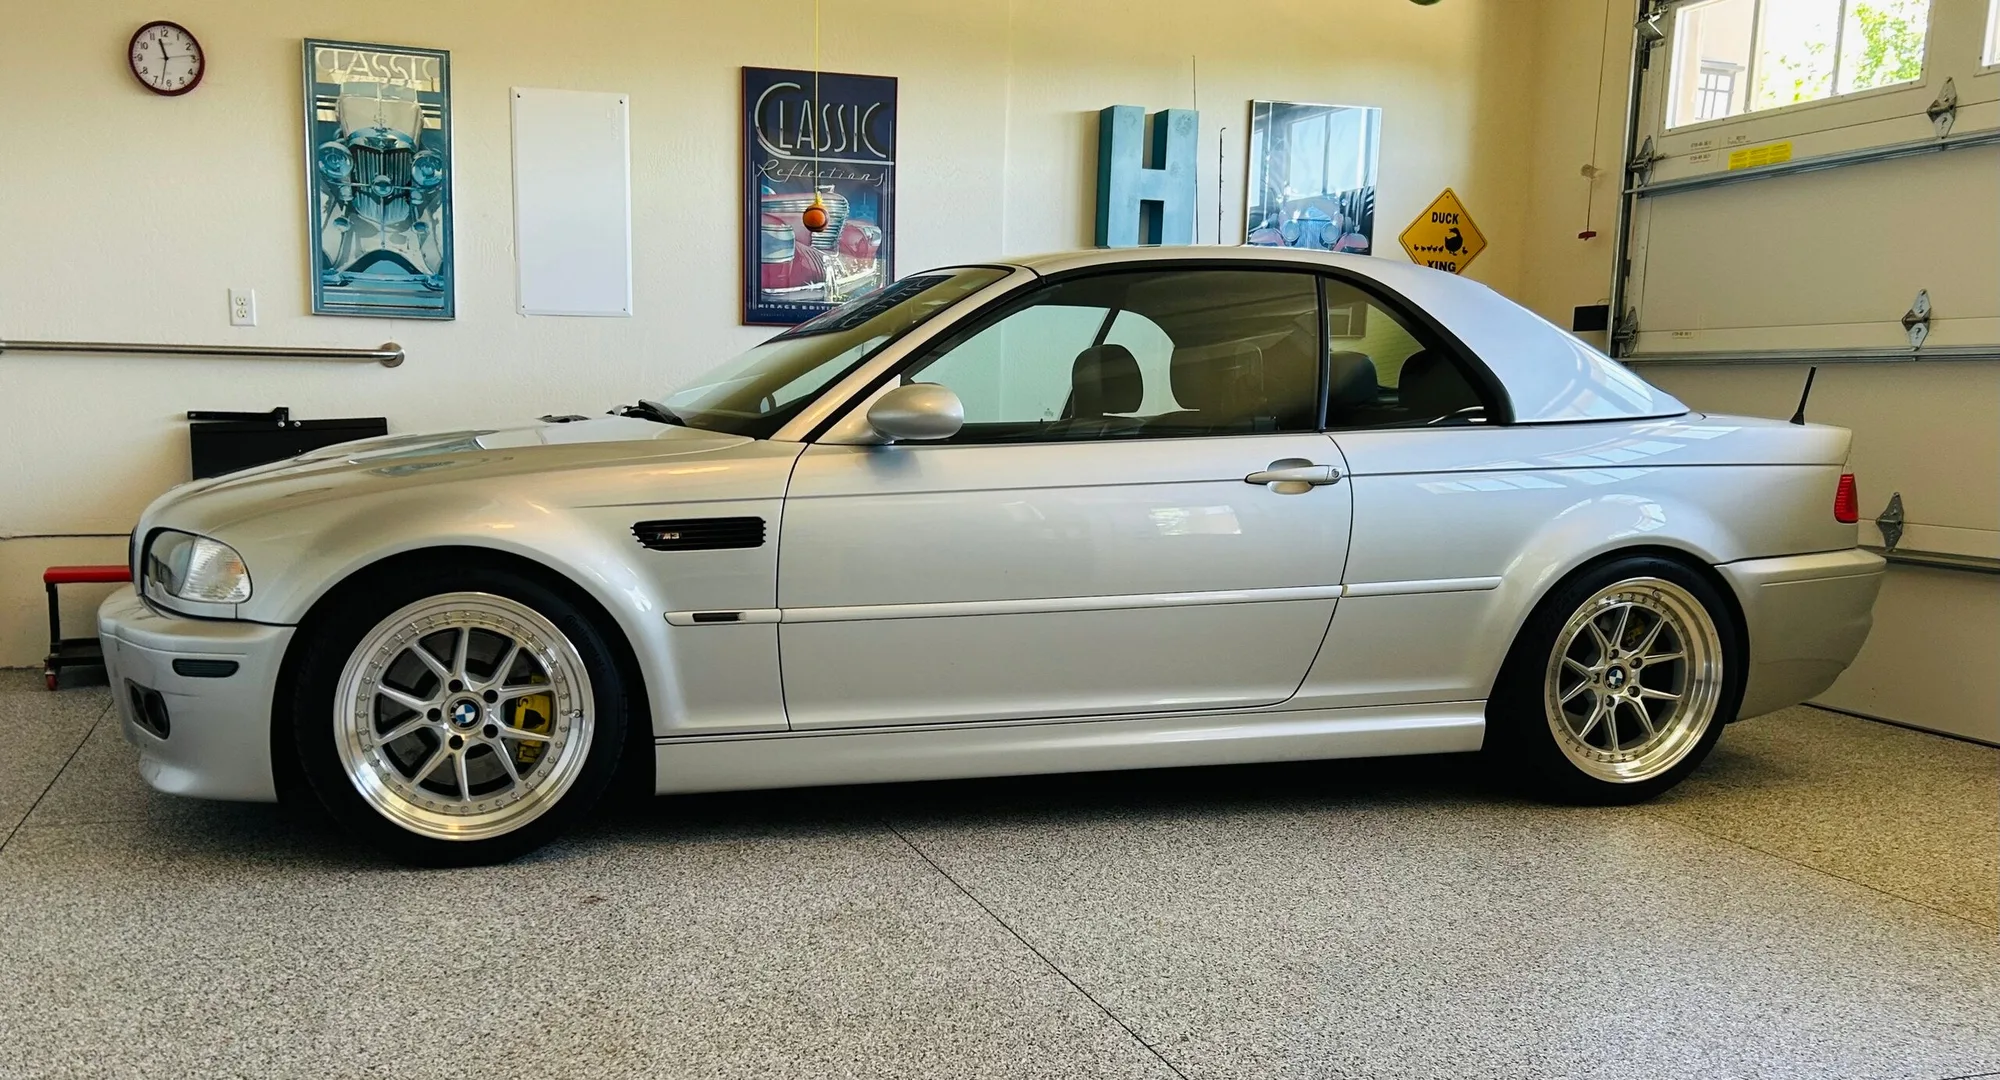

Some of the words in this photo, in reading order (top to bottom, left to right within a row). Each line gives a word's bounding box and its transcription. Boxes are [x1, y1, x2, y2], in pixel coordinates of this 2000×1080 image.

[149, 33, 156, 41] 11
[160, 29, 169, 38] 12
[140, 42, 149, 50] 10
[185, 42, 192, 51] 2
[136, 53, 143, 62] 9
[190, 54, 197, 64] 3
[142, 66, 149, 75] 8
[187, 68, 194, 76] 4
[315, 49, 440, 89] CLASSIC
[153, 75, 159, 84] 7
[165, 79, 172, 88] 6
[178, 76, 185, 85] 5
[754, 82, 887, 158] CLASSIC
[756, 159, 885, 188] Reflections
[1096, 105, 1200, 248] H
[1431, 211, 1460, 225] DUCK
[1427, 259, 1457, 273] XING
